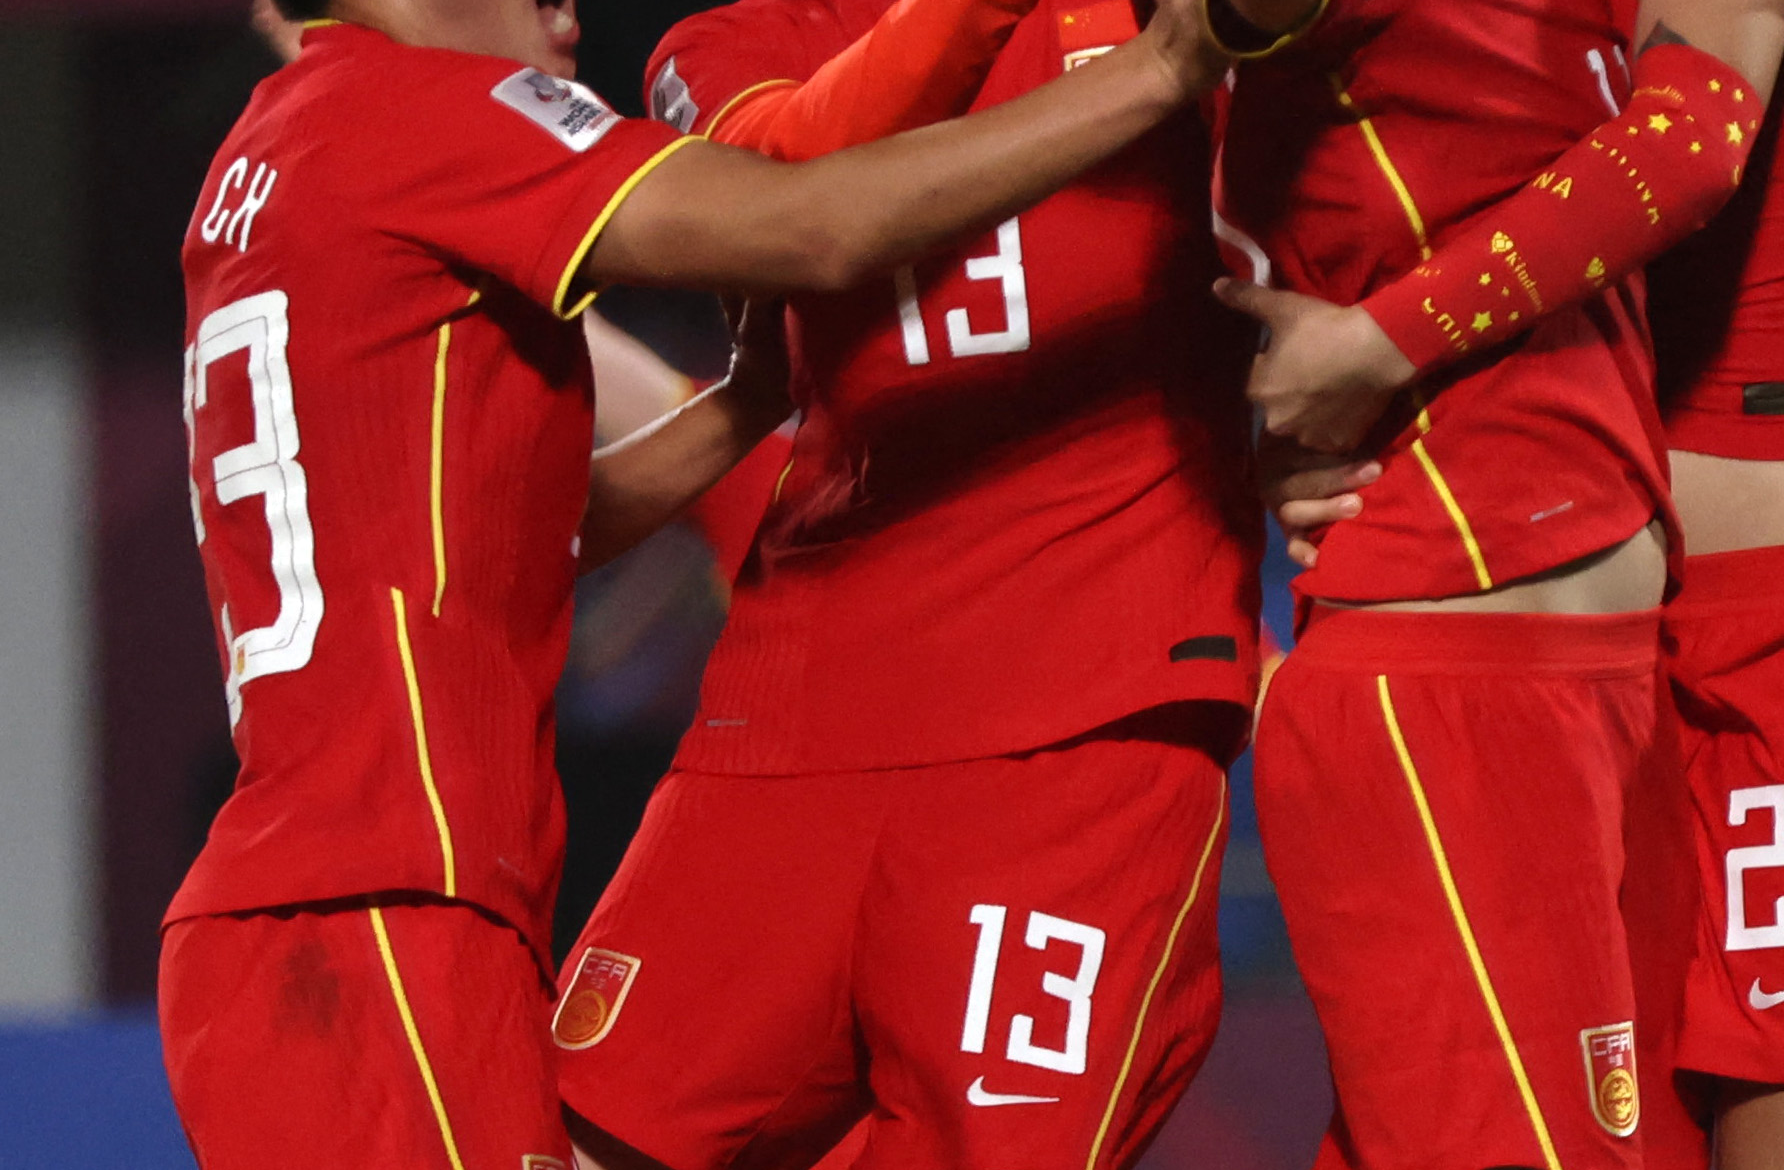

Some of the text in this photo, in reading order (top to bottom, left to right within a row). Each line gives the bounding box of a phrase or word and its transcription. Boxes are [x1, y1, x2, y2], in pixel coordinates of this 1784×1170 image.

[201, 156, 278, 253] CH
[184, 288, 324, 736] 3
[584, 957, 628, 982] CFA
[960, 904, 1107, 1075] 13
[1591, 1032, 1631, 1056] CFA
